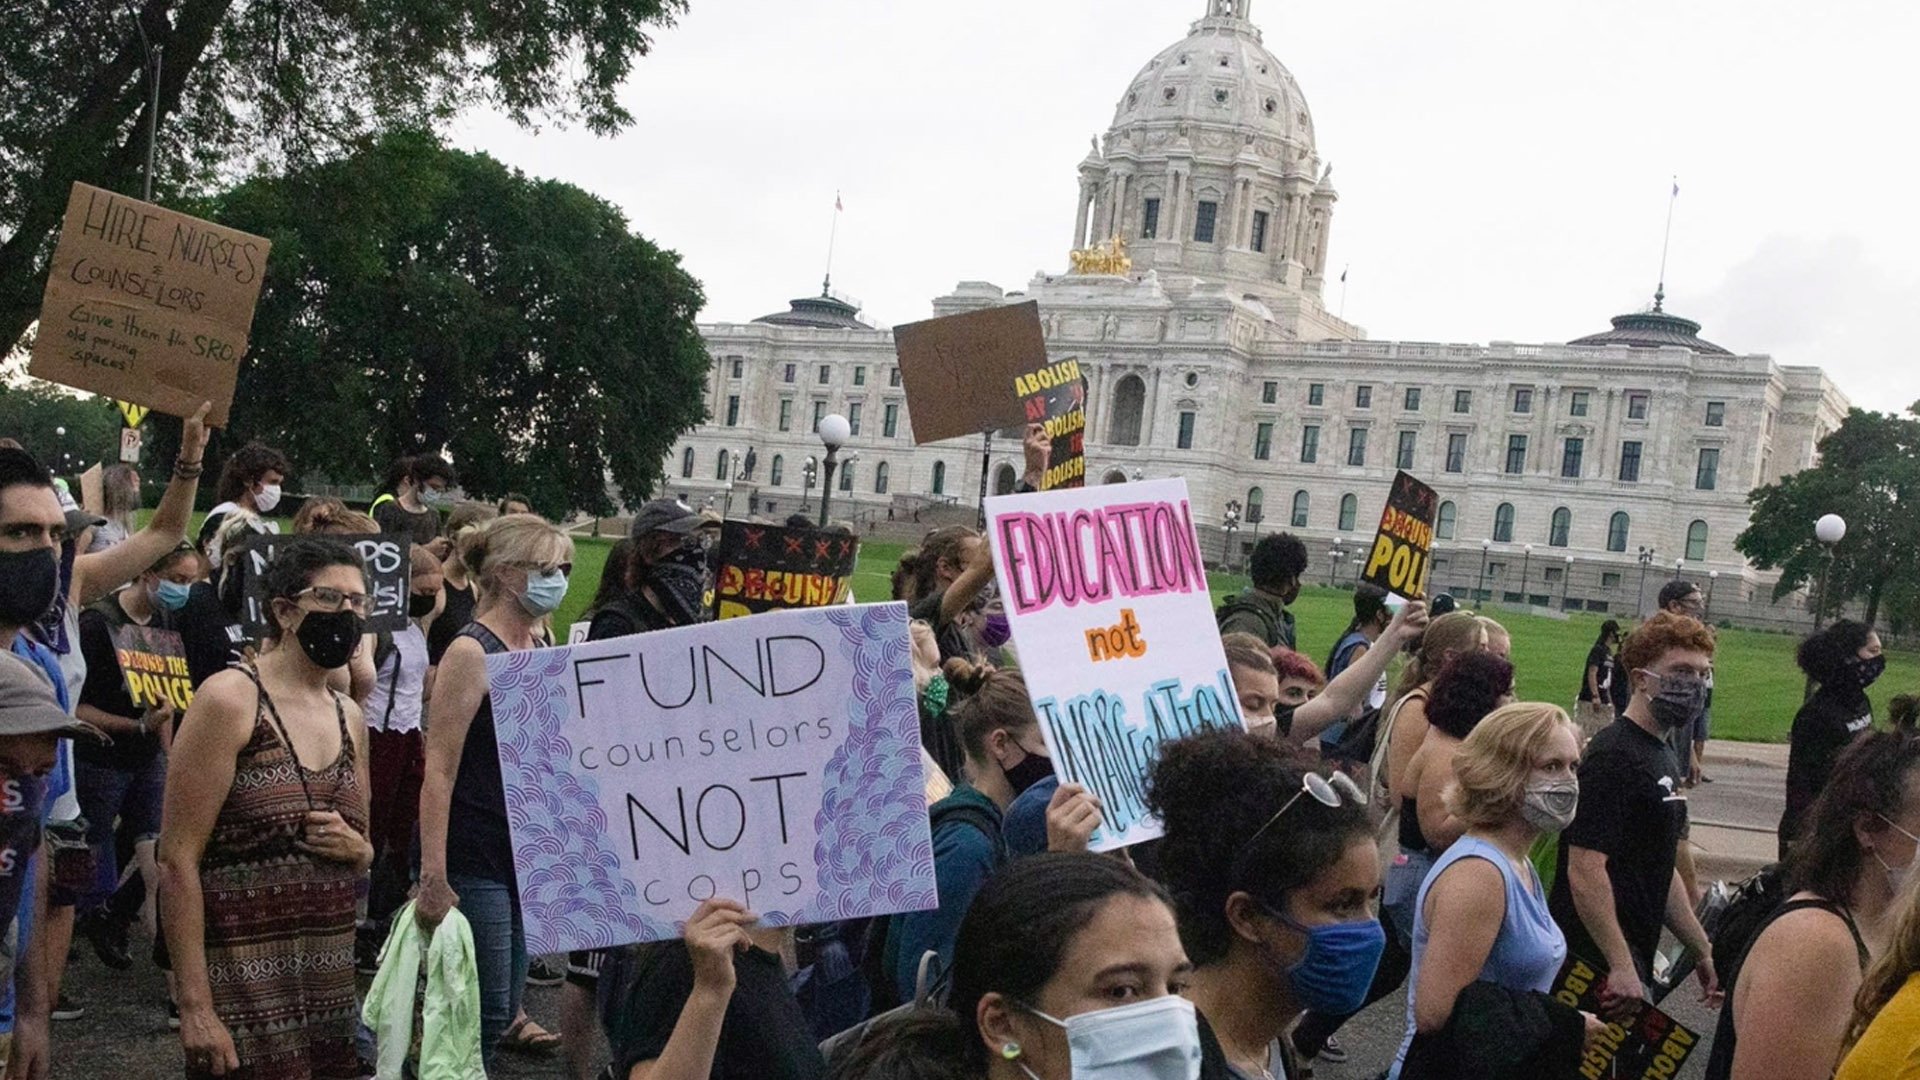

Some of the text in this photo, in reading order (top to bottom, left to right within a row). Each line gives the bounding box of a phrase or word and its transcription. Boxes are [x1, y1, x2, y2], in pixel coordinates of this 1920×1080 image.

[83, 191, 258, 285] HIRE NURSES
[70, 257, 205, 313] COUNSELORS
[66, 326, 87, 342] old
[68, 304, 113, 328] Give
[121, 314, 160, 342] them
[1015, 359, 1080, 398] ABOLISH
[1044, 409, 1085, 438] BOLISH
[354, 540, 401, 573] PS
[998, 500, 1204, 614] EDUCATION
[1087, 610, 1145, 660] not
[165, 655, 189, 676] THE
[573, 635, 825, 719] FUND
[579, 715, 833, 771] counselors
[626, 771, 808, 861] NOT
[643, 861, 803, 910] cops
